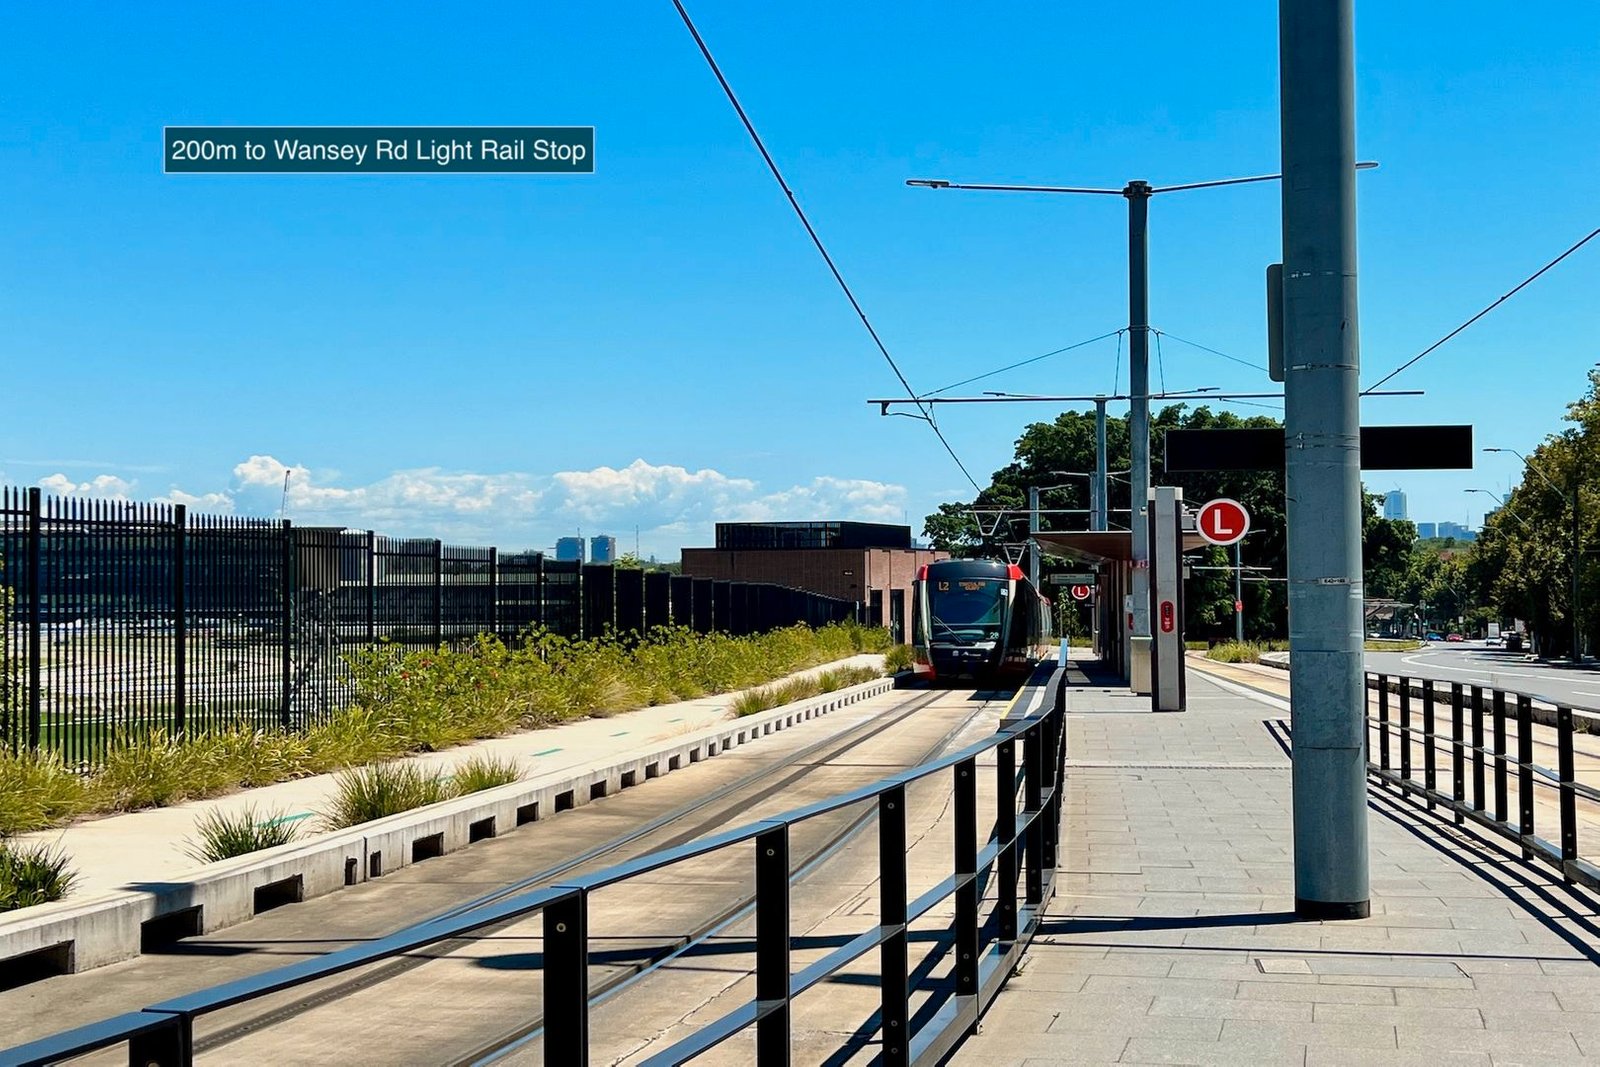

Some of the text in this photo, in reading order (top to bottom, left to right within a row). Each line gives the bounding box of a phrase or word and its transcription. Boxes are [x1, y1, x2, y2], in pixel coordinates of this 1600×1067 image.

[1214, 509, 1233, 534] L
[938, 581, 950, 591] L2
[1077, 586, 1085, 596] L
